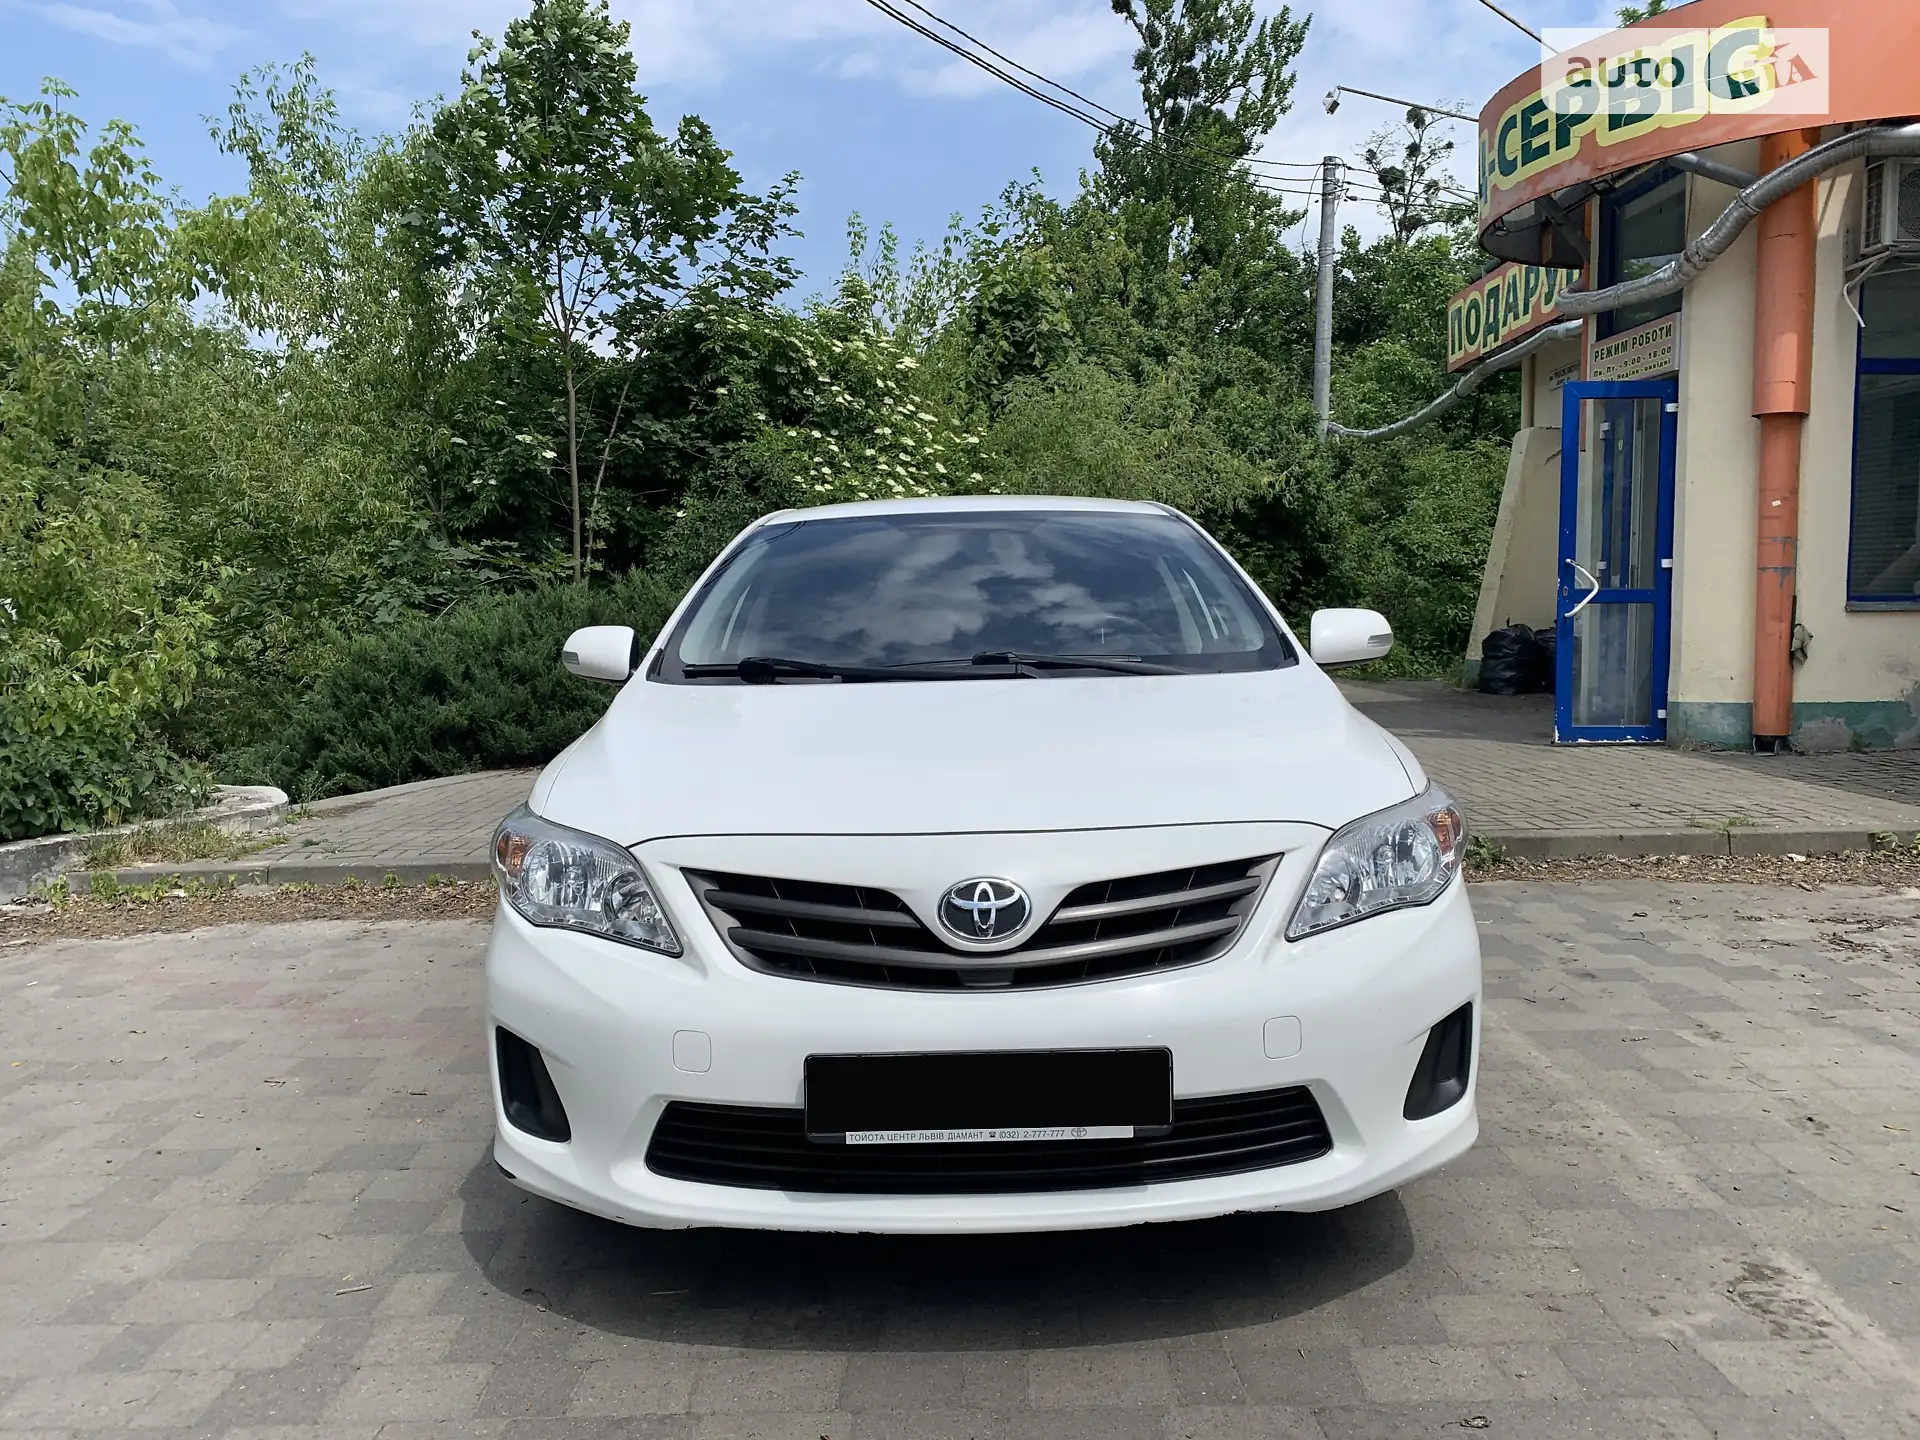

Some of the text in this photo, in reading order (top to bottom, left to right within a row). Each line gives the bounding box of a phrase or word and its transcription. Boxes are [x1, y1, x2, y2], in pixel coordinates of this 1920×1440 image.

[1594, 323, 1672, 362] РЕЖИМ РОБОТИ
[849, 1129, 1066, 1142] ТОЙОТА ЦЕНТР ЛЬВІВ ДІАМАНТ (032) 2-777-777
